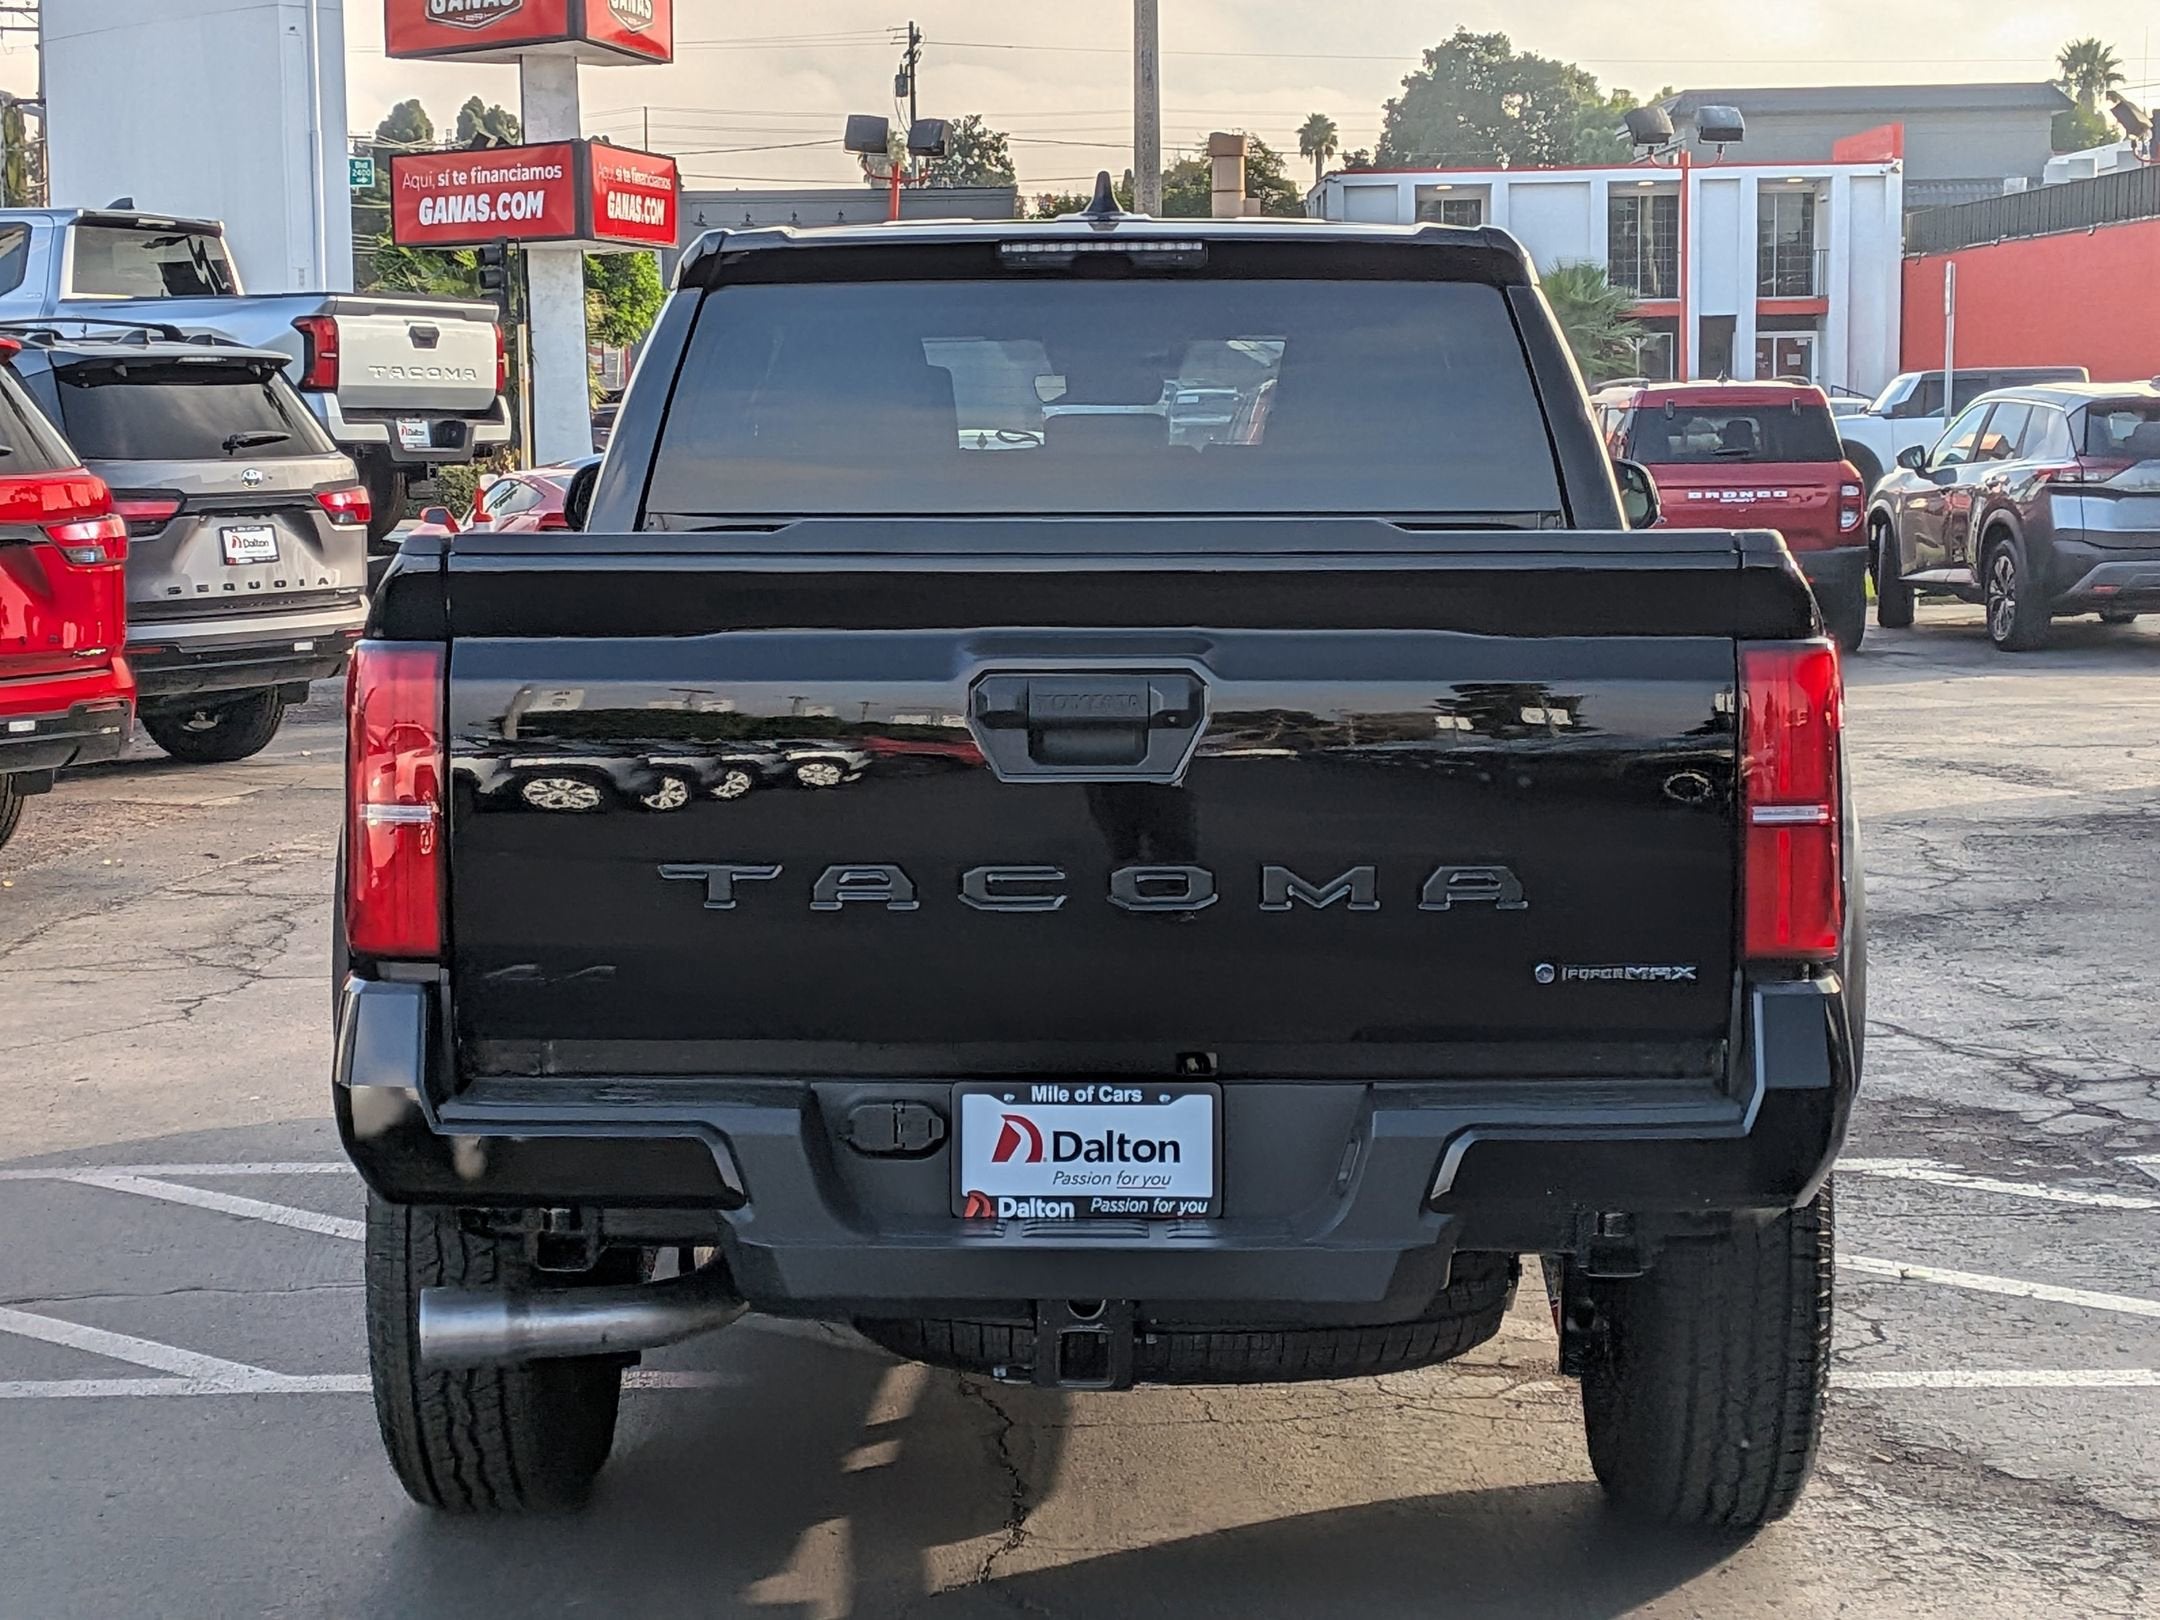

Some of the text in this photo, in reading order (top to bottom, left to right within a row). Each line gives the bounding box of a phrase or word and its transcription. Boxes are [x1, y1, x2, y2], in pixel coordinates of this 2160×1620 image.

[452, 170, 468, 186] te
[470, 163, 563, 185] financiamos
[418, 190, 545, 227] GANAS.COM
[607, 190, 666, 226] GANAS.COM
[368, 365, 477, 381] TACOMA
[243, 538, 270, 548] Dalton
[167, 577, 329, 595] SEQUOIA
[657, 864, 1529, 912] TACOMA
[1031, 1085, 1143, 1102] Mile of Cars
[1052, 1130, 1181, 1163] Dalton
[1052, 1170, 1172, 1188] Passion for you
[998, 1197, 1209, 1218] Dalton Passion for you
